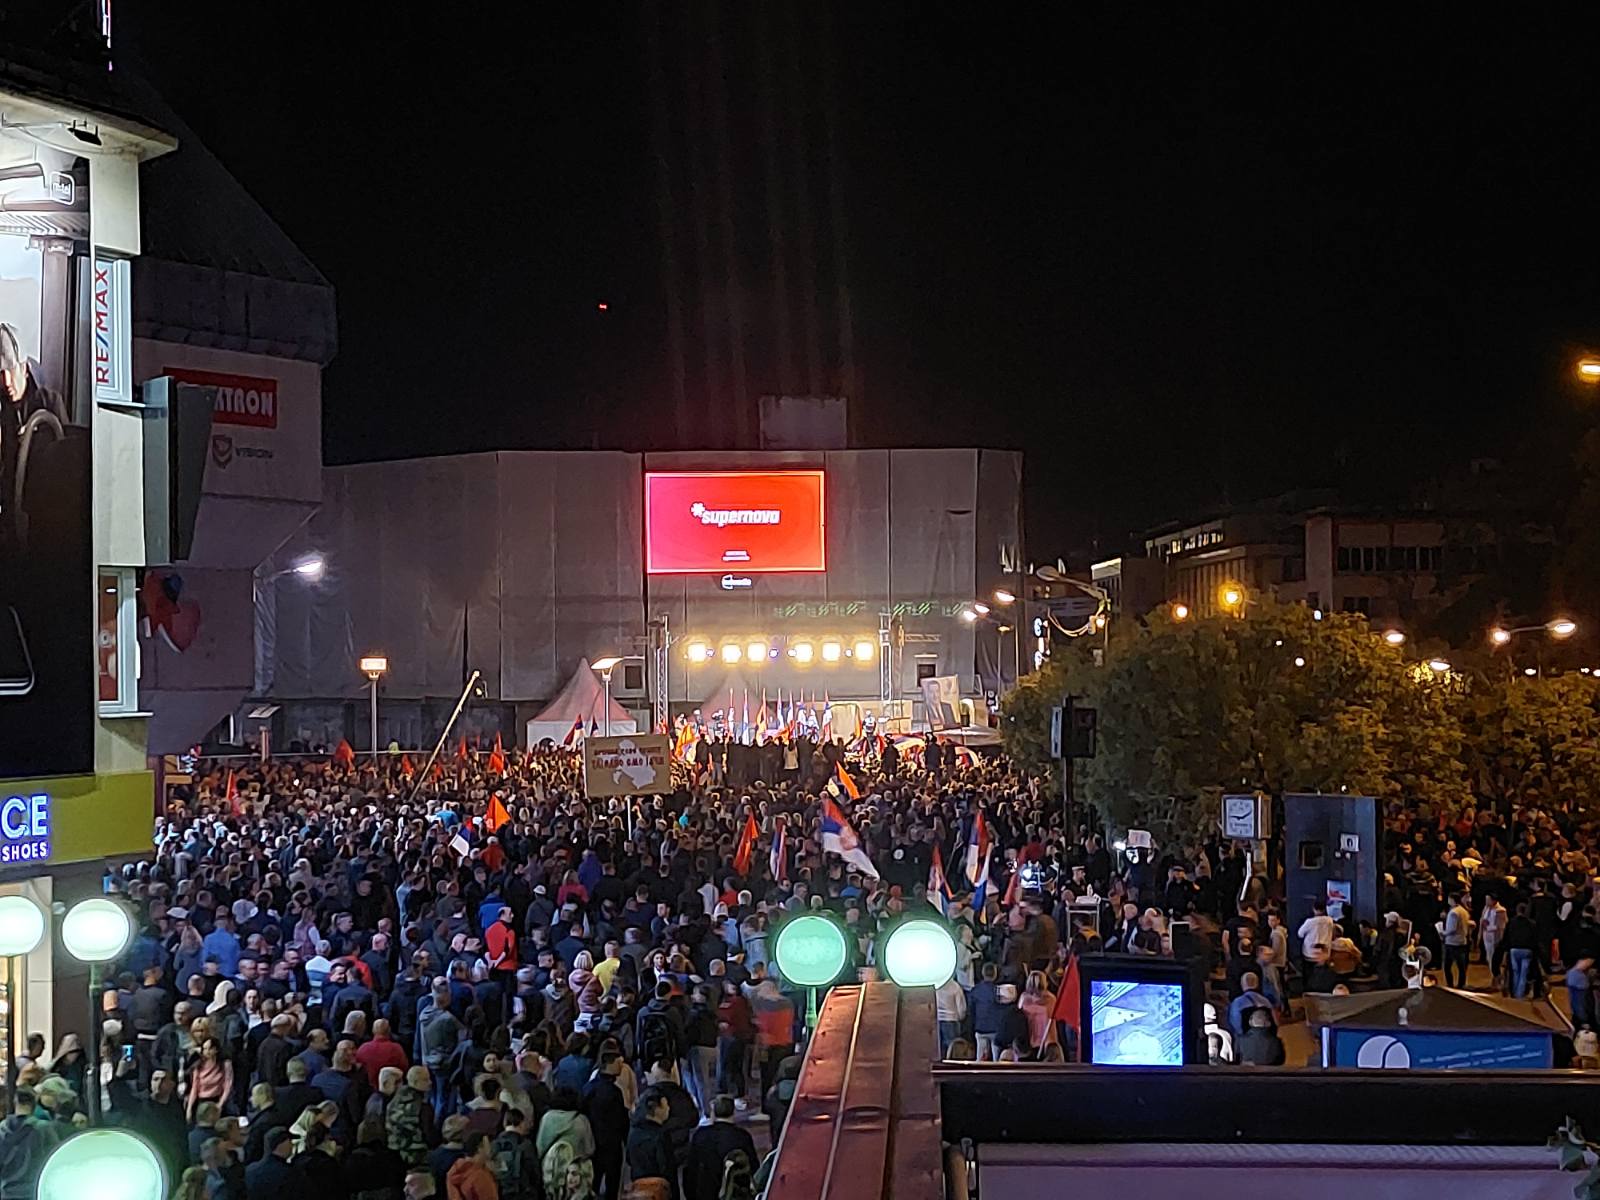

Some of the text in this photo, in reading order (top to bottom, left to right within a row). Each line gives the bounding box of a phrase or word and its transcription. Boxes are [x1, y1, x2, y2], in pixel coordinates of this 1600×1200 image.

[96, 269, 110, 383] RE/MAX
[700, 509, 780, 528] supernova
[1, 795, 47, 838] CE
[2, 842, 48, 862] SHOES
